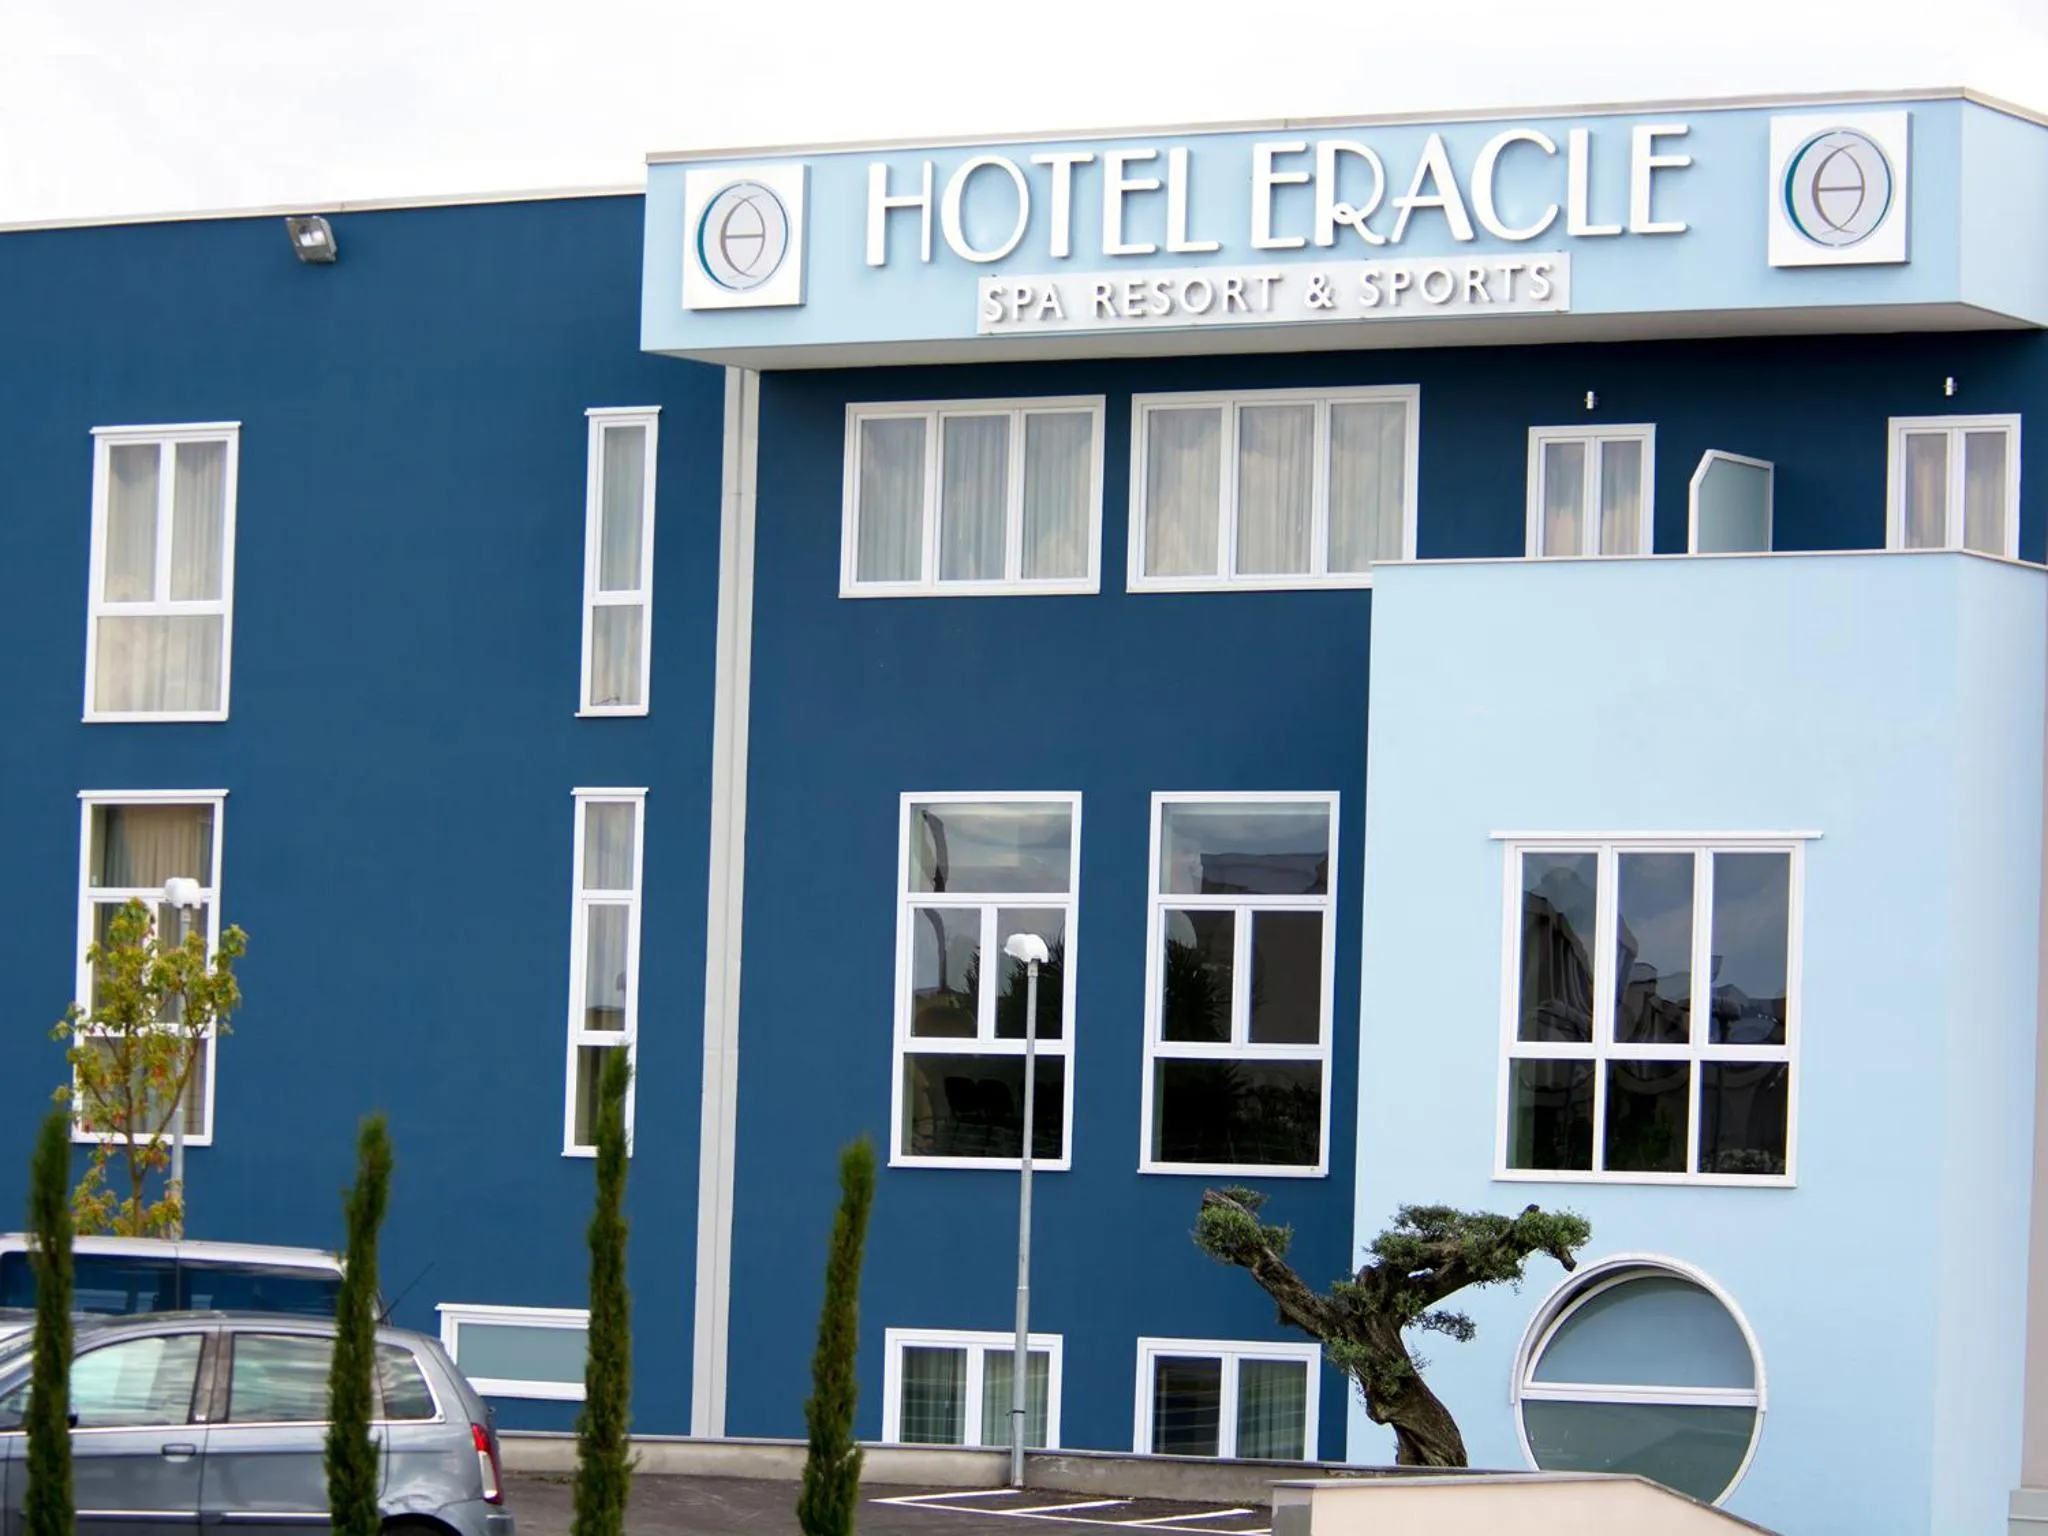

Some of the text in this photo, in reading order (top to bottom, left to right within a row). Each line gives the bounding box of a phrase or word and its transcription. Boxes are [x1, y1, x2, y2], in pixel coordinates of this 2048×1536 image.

[866, 123, 1693, 267] HOTEL ERACLE
[984, 261, 1553, 322] SPA RESORT & SPORTS
